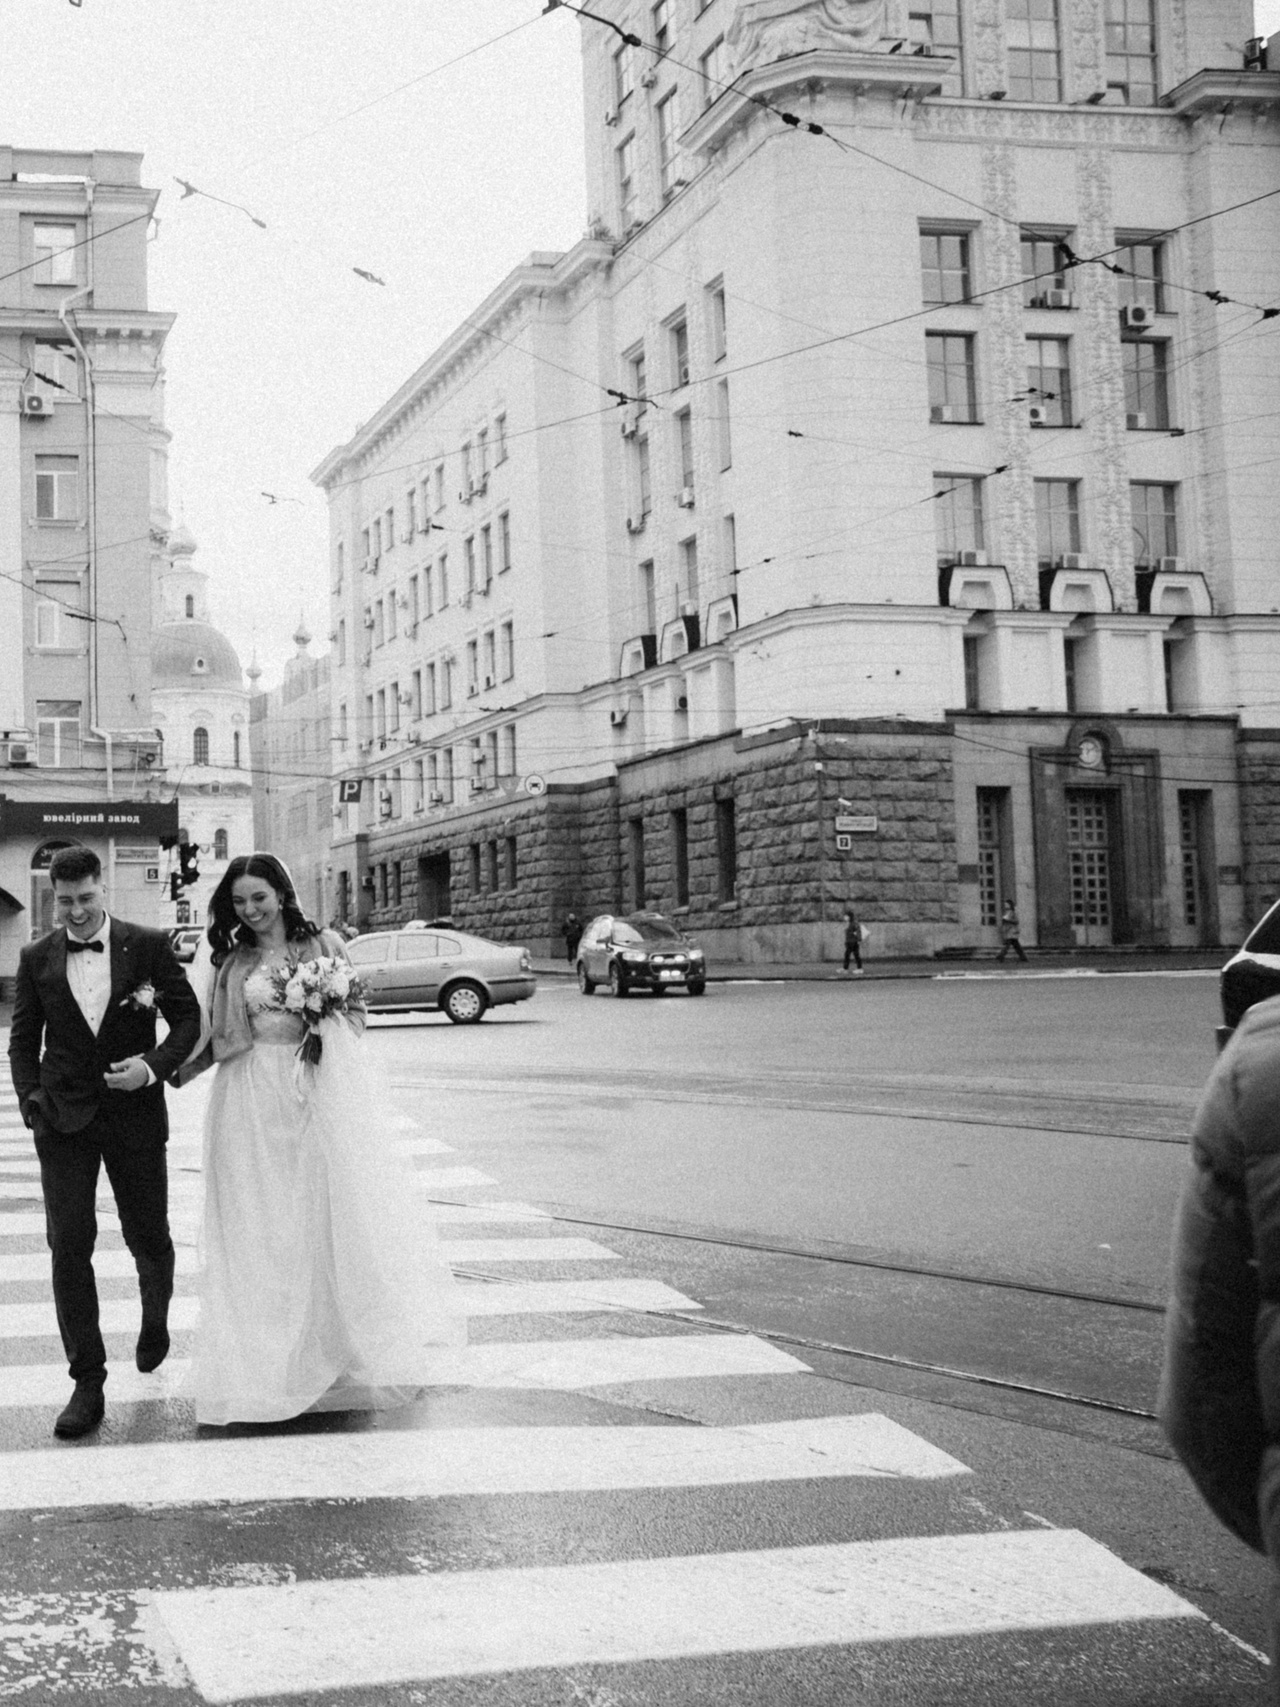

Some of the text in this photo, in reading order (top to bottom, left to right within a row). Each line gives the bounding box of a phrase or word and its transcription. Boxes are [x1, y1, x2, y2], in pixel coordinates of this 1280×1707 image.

[344, 781, 359, 801] P
[42, 812, 140, 824] ювелірний завод
